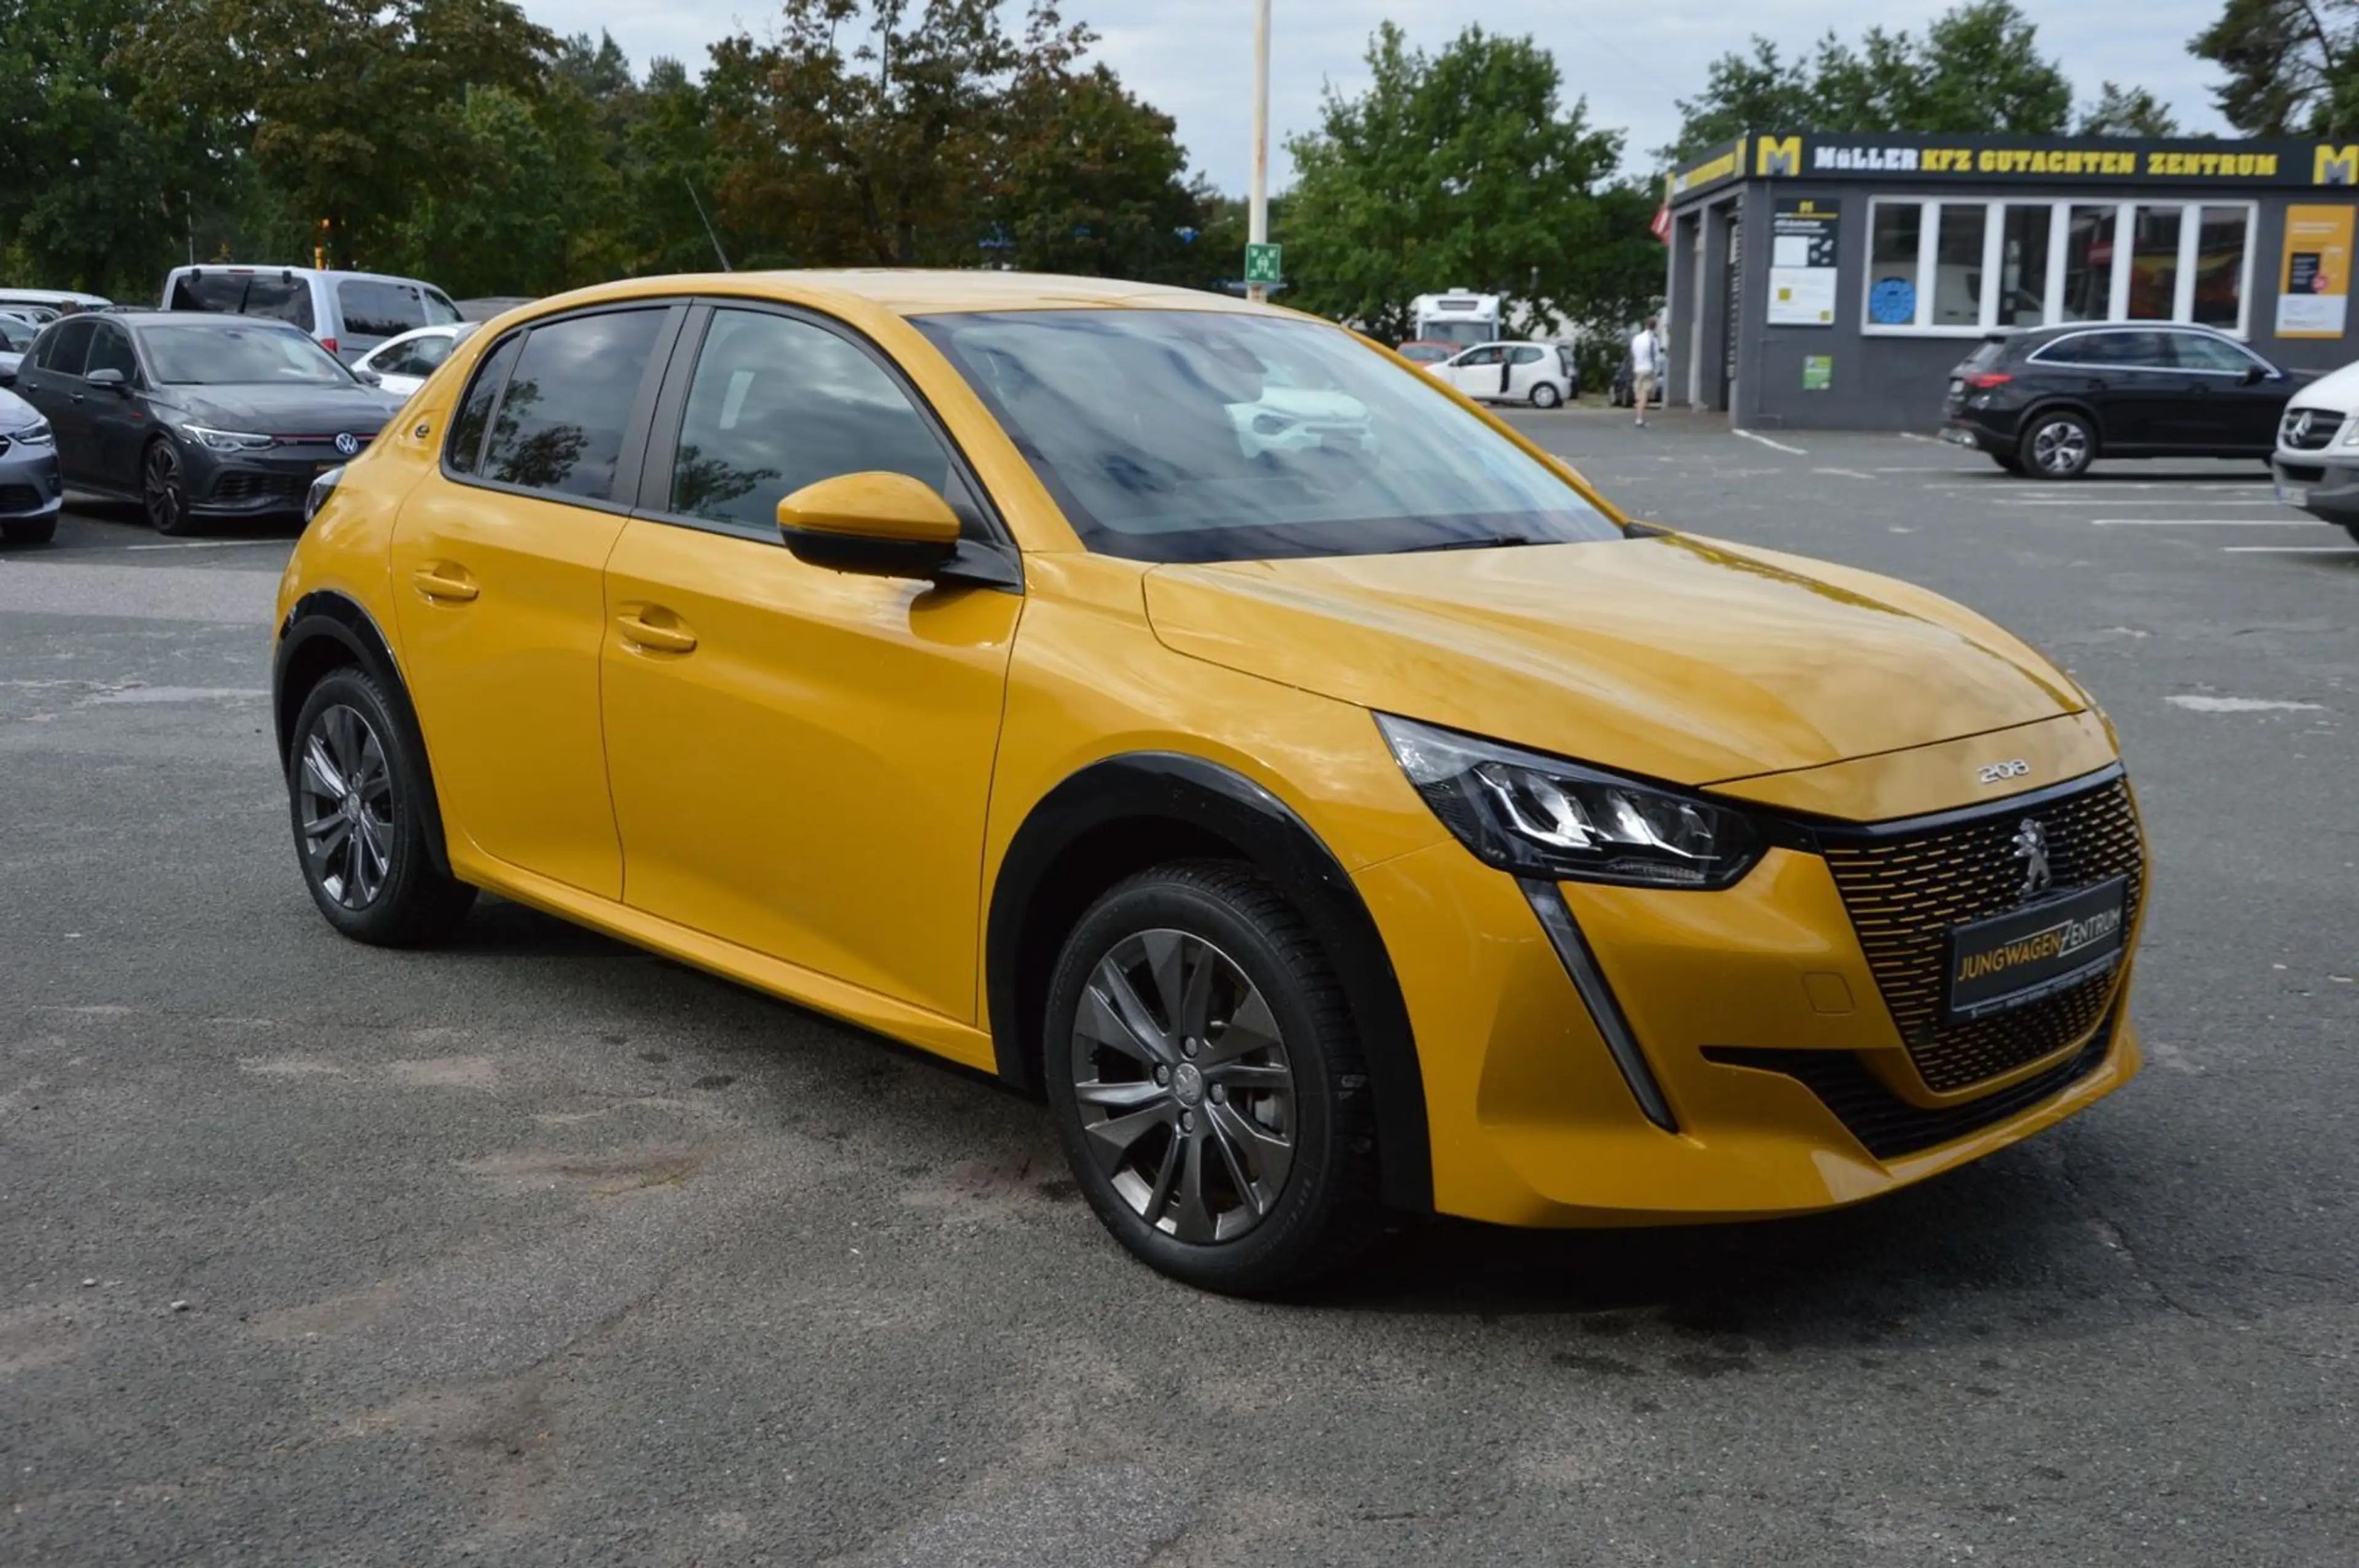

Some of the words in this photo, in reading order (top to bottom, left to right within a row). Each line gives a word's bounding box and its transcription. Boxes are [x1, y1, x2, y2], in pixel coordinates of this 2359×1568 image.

[1756, 136, 1802, 176] M
[1920, 148, 1973, 171] KFZ
[1978, 150, 2136, 174] GUTACHTEN
[2147, 152, 2278, 176] ZENTRUM
[1978, 759, 2029, 782] 208
